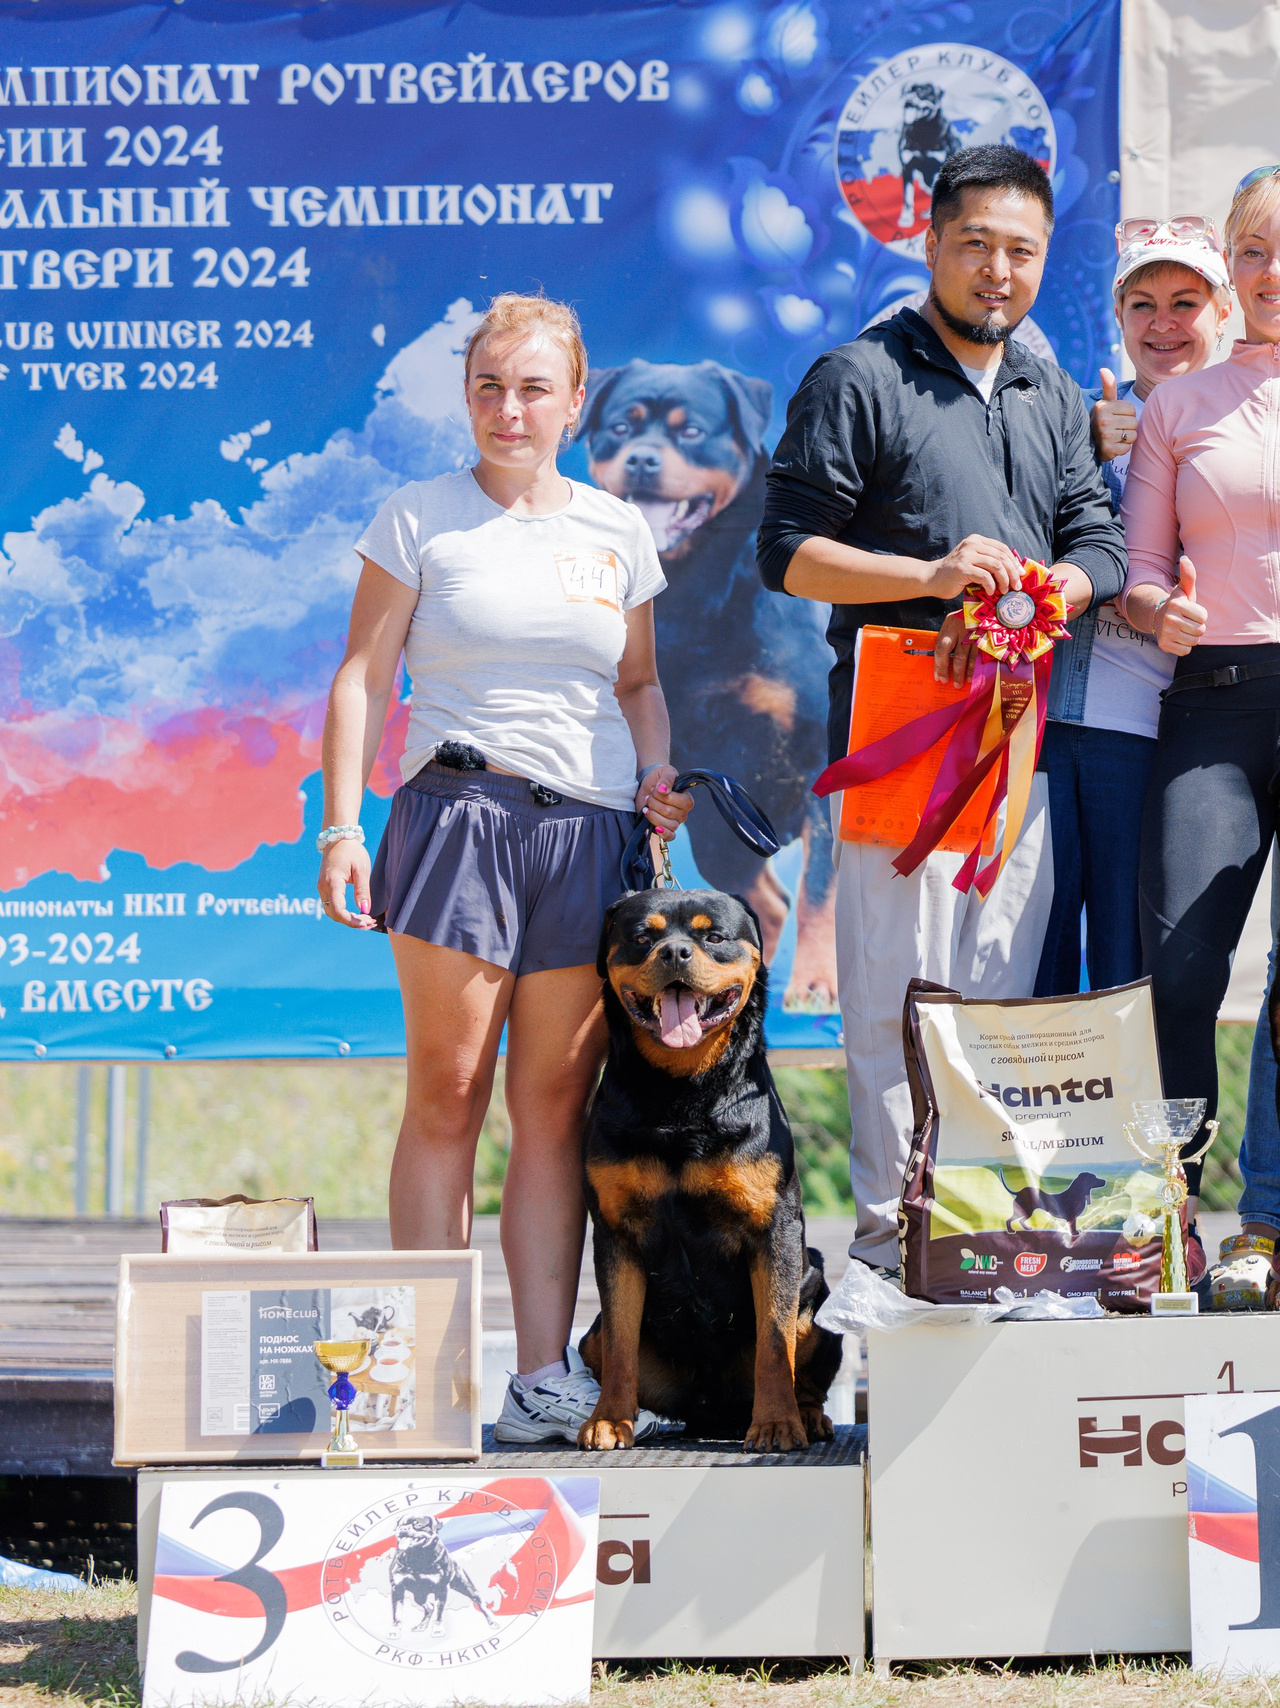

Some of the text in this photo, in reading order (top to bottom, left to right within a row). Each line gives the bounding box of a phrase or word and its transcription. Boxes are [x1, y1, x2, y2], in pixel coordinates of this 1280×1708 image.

[278, 53, 670, 105] РОТВЕЙЛЕРОВ
[938, 52, 1010, 84] КЛУБ
[0, 125, 223, 167] ИИ 2024
[250, 183, 613, 227] ЧЕМПИОНАТ
[0, 247, 311, 290] ТВЕРИ 2024
[0, 319, 314, 350] UB WINNER 2024
[22, 361, 127, 391] TVER
[139, 361, 219, 390] 2024
[1115, 621, 1147, 647] Cup
[124, 893, 187, 917] НКП
[21, 978, 214, 1013] ВМЕСТЕ
[980, 1033, 999, 1042] Корм
[1016, 1029, 1077, 1041] полнорационный
[1079, 1028, 1092, 1037] для
[1021, 1040, 1047, 1049] мелких
[1054, 1039, 1082, 1048] средних
[1083, 1033, 1105, 1045] пород
[990, 1051, 1085, 1065] с говядиной и рисом
[1015, 1110, 1072, 1121] premium
[1001, 1131, 1105, 1151] SMLL/MEDIUM
[251, 1241, 272, 1249] рисом
[975, 1255, 998, 1270] NWC
[1020, 1256, 1041, 1265] FRESH
[1020, 1264, 1038, 1273] MEAT
[259, 1308, 318, 1319] HOMECLUB
[260, 1335, 300, 1345] ПОДНОС
[260, 1345, 314, 1355] НА НОЖКАХ
[325, 1493, 420, 1623] РОТВЕЙЛЕР
[438, 1488, 513, 1519] КЛУБ
[519, 1521, 557, 1620] РОССИИ
[175, 1490, 288, 1673] 3
[375, 1635, 502, 1668] РКФ-НКПР
